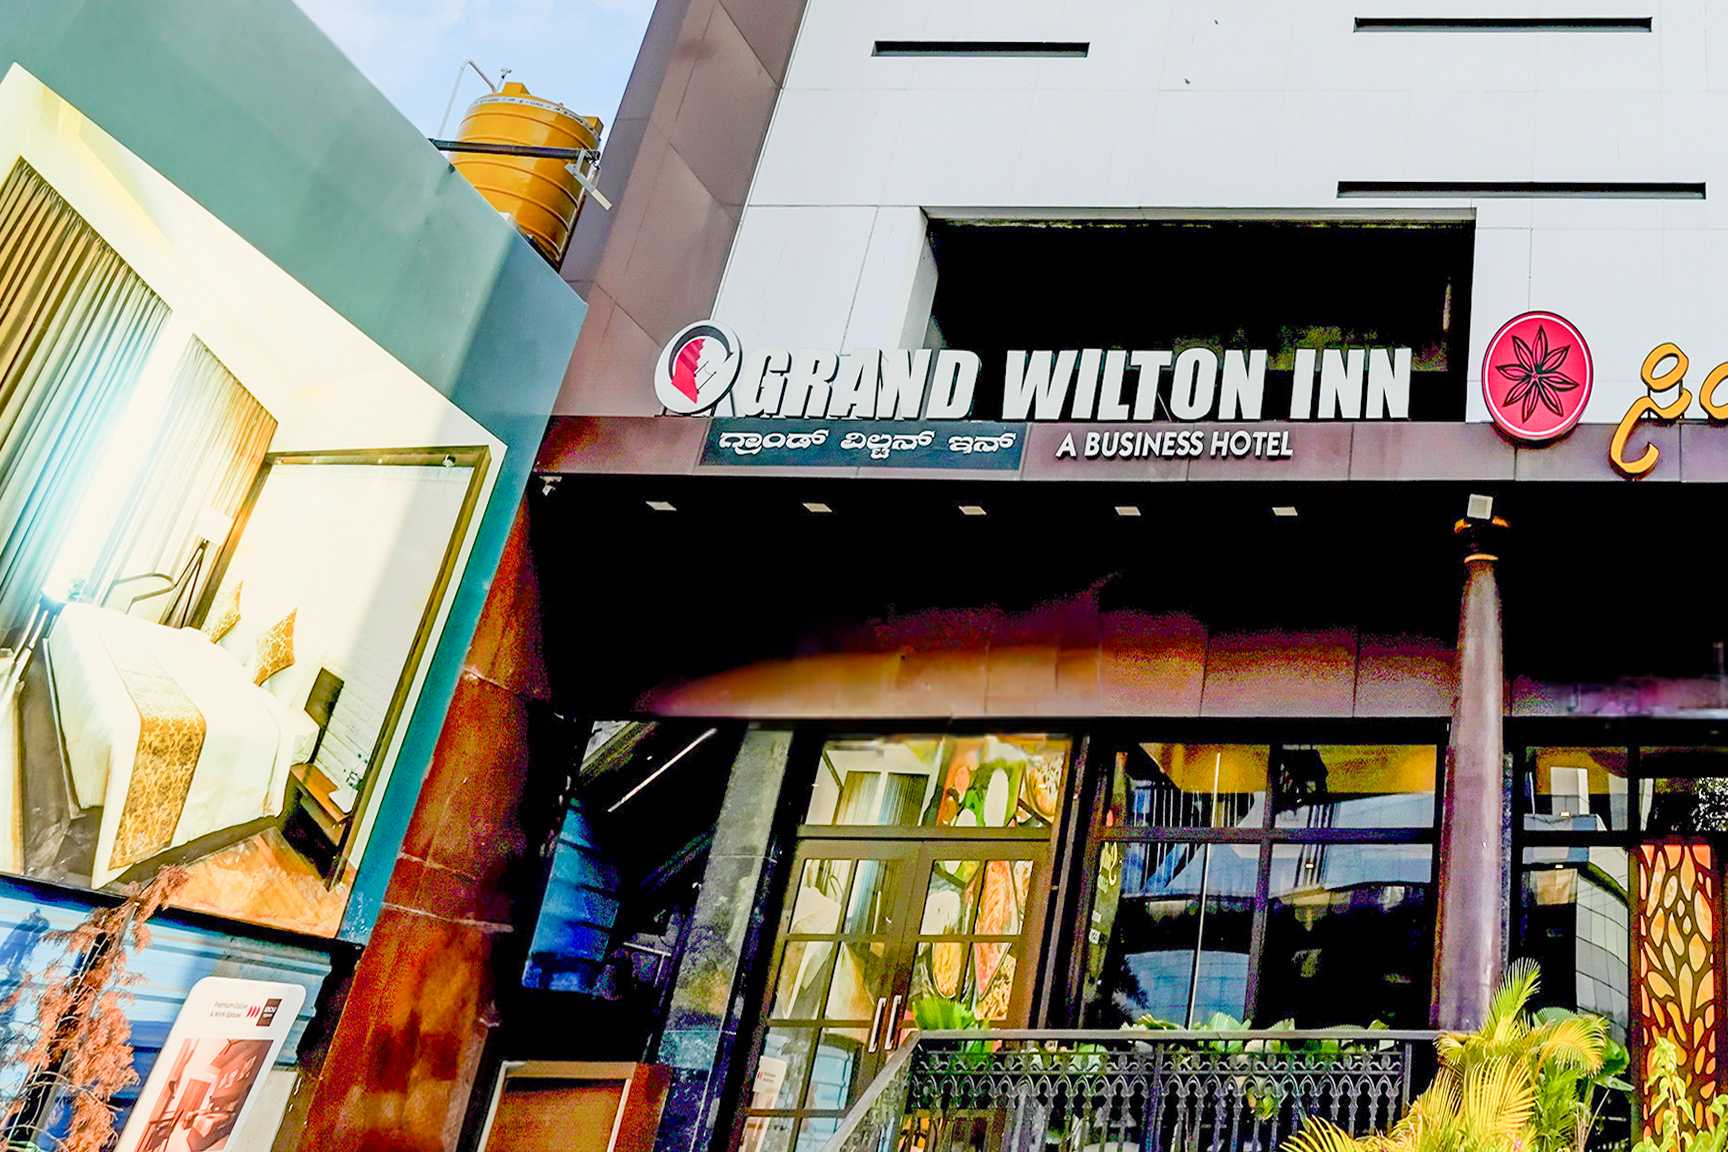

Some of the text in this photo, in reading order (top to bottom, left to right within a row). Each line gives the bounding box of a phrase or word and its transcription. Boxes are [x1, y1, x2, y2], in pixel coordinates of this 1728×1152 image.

[745, 348, 1412, 421] GRAND WILTON INN
[947, 431, 1017, 454] ಇನ್
[1056, 430, 1294, 457] A BUSINESS HOTEL
